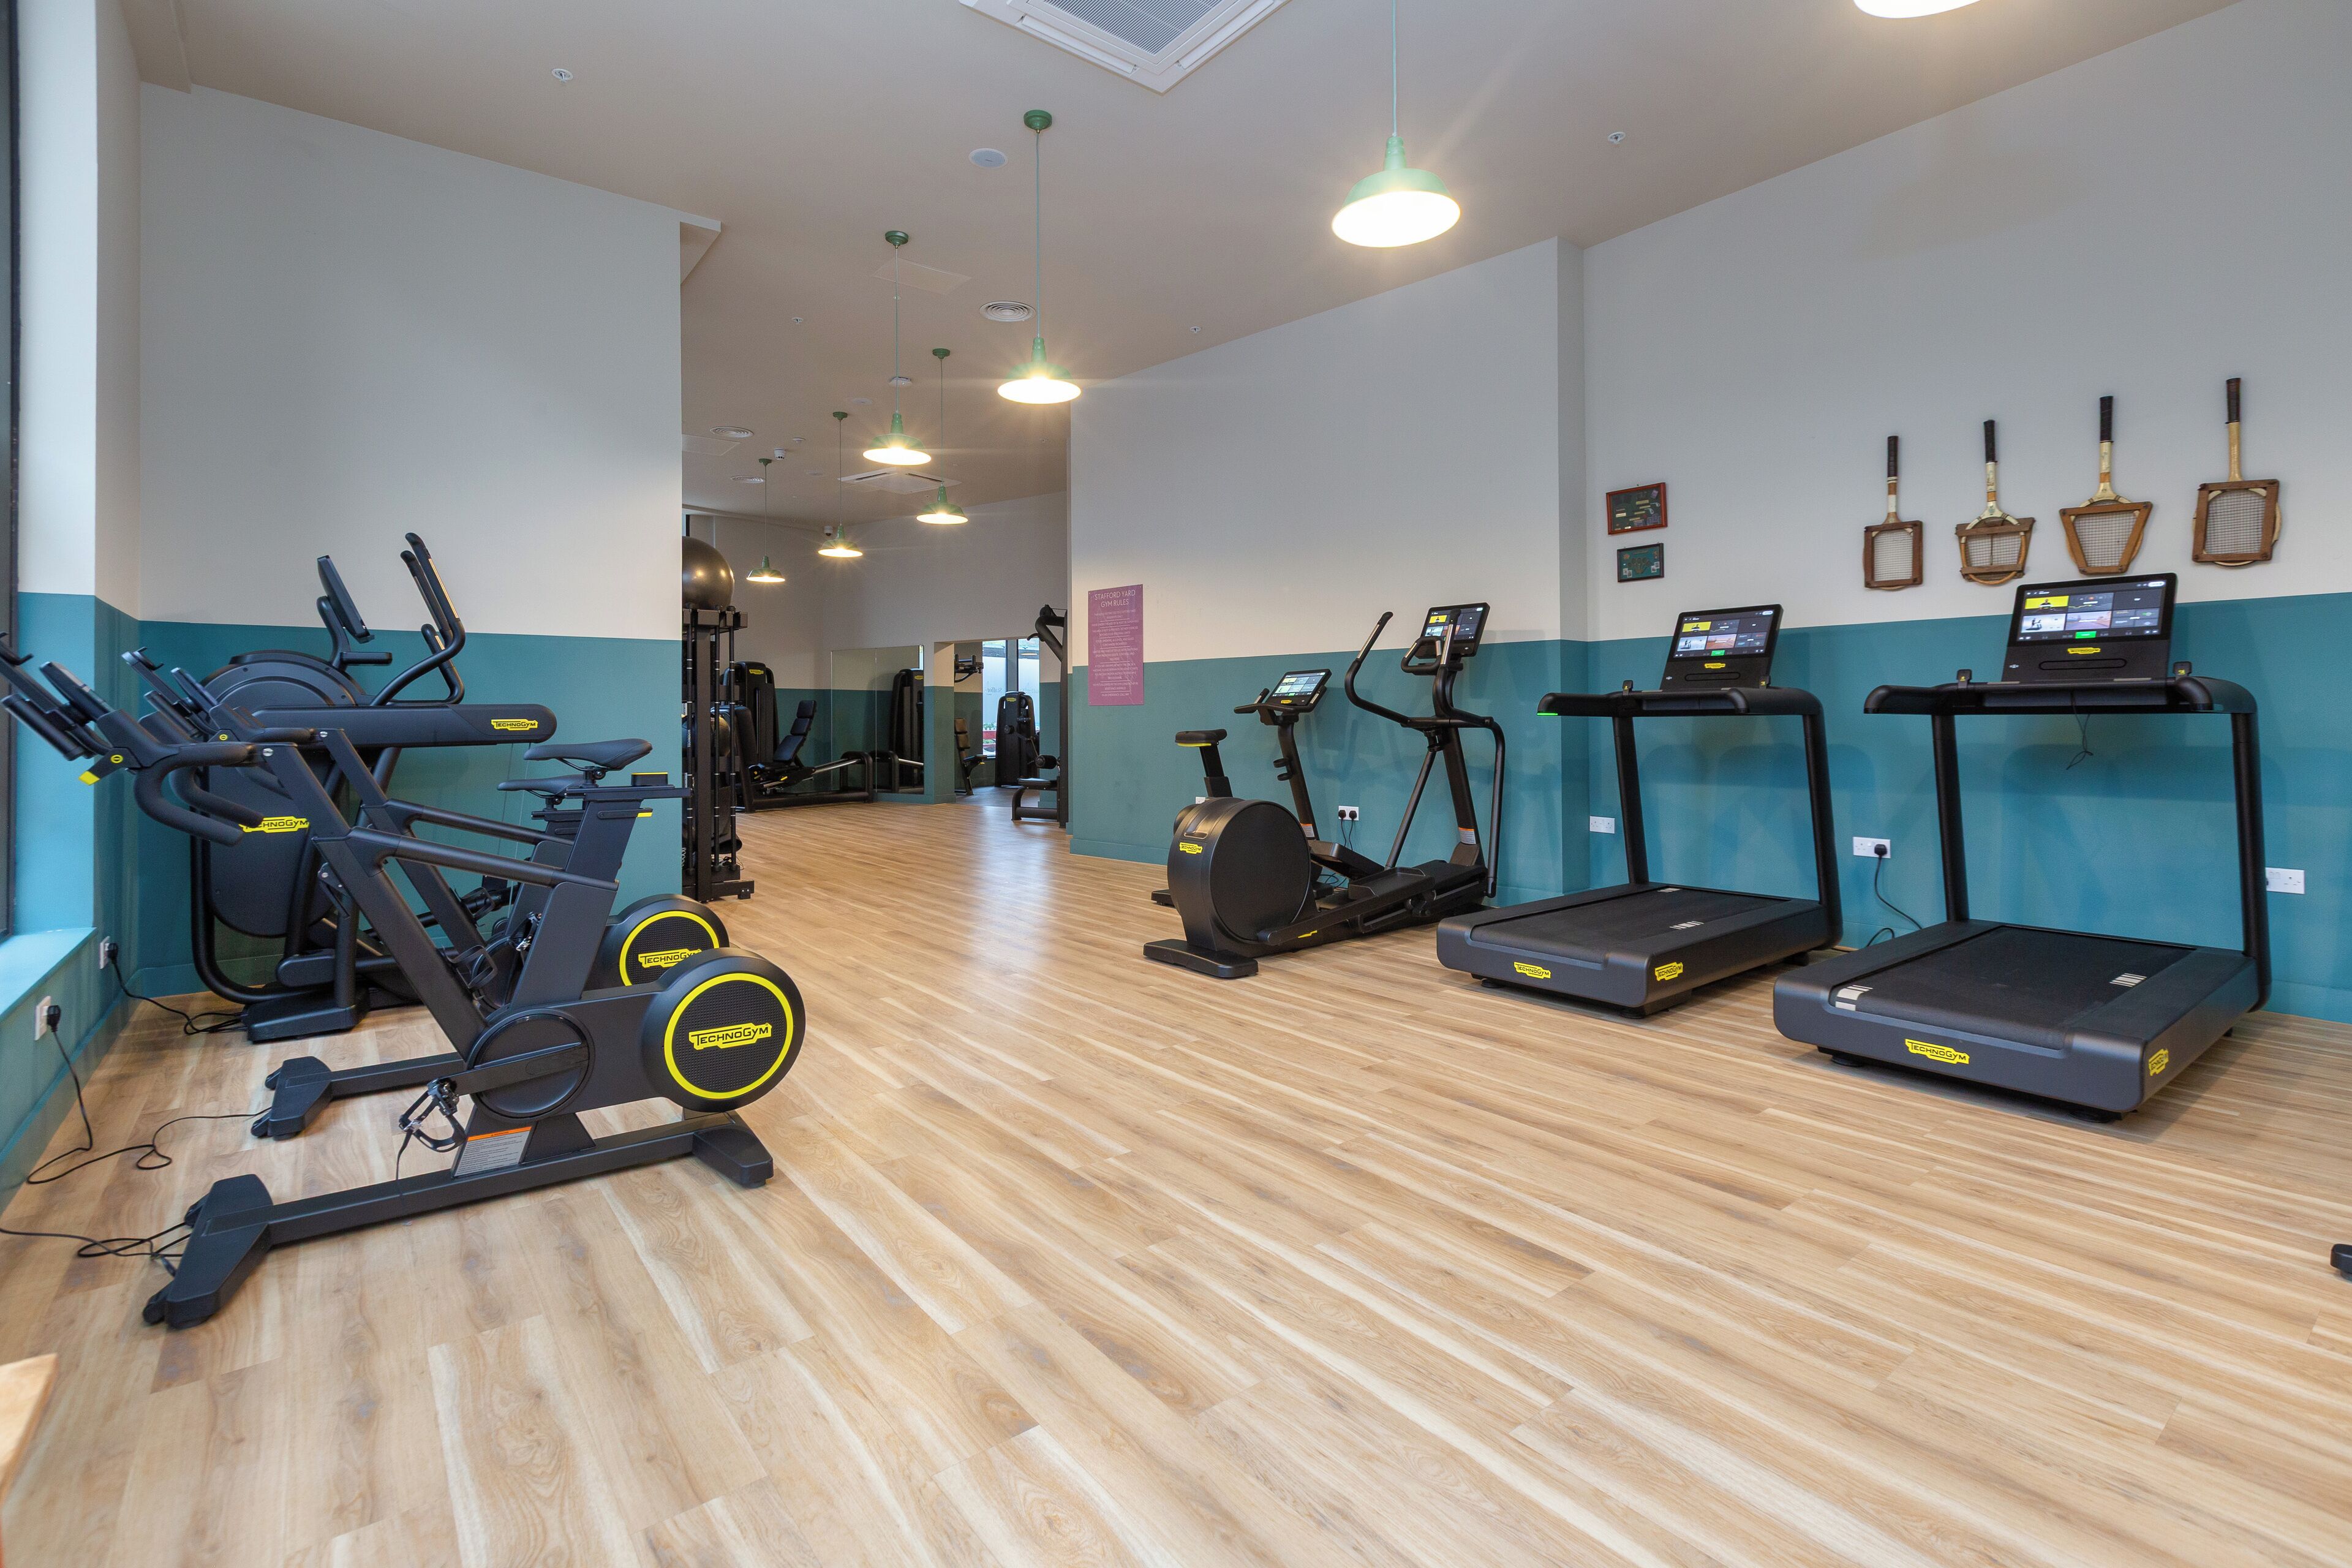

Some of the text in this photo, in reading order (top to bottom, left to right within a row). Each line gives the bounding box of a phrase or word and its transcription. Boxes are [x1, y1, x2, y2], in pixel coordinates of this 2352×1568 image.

[1094, 591, 1121, 600] STAFFORD
[245, 819, 308, 830] HNOGYM
[1515, 963, 1550, 976] TECHNOGYM
[691, 1027, 769, 1046] TECHNOGYM
[1907, 1041, 1967, 1061] TECHNOGYM
